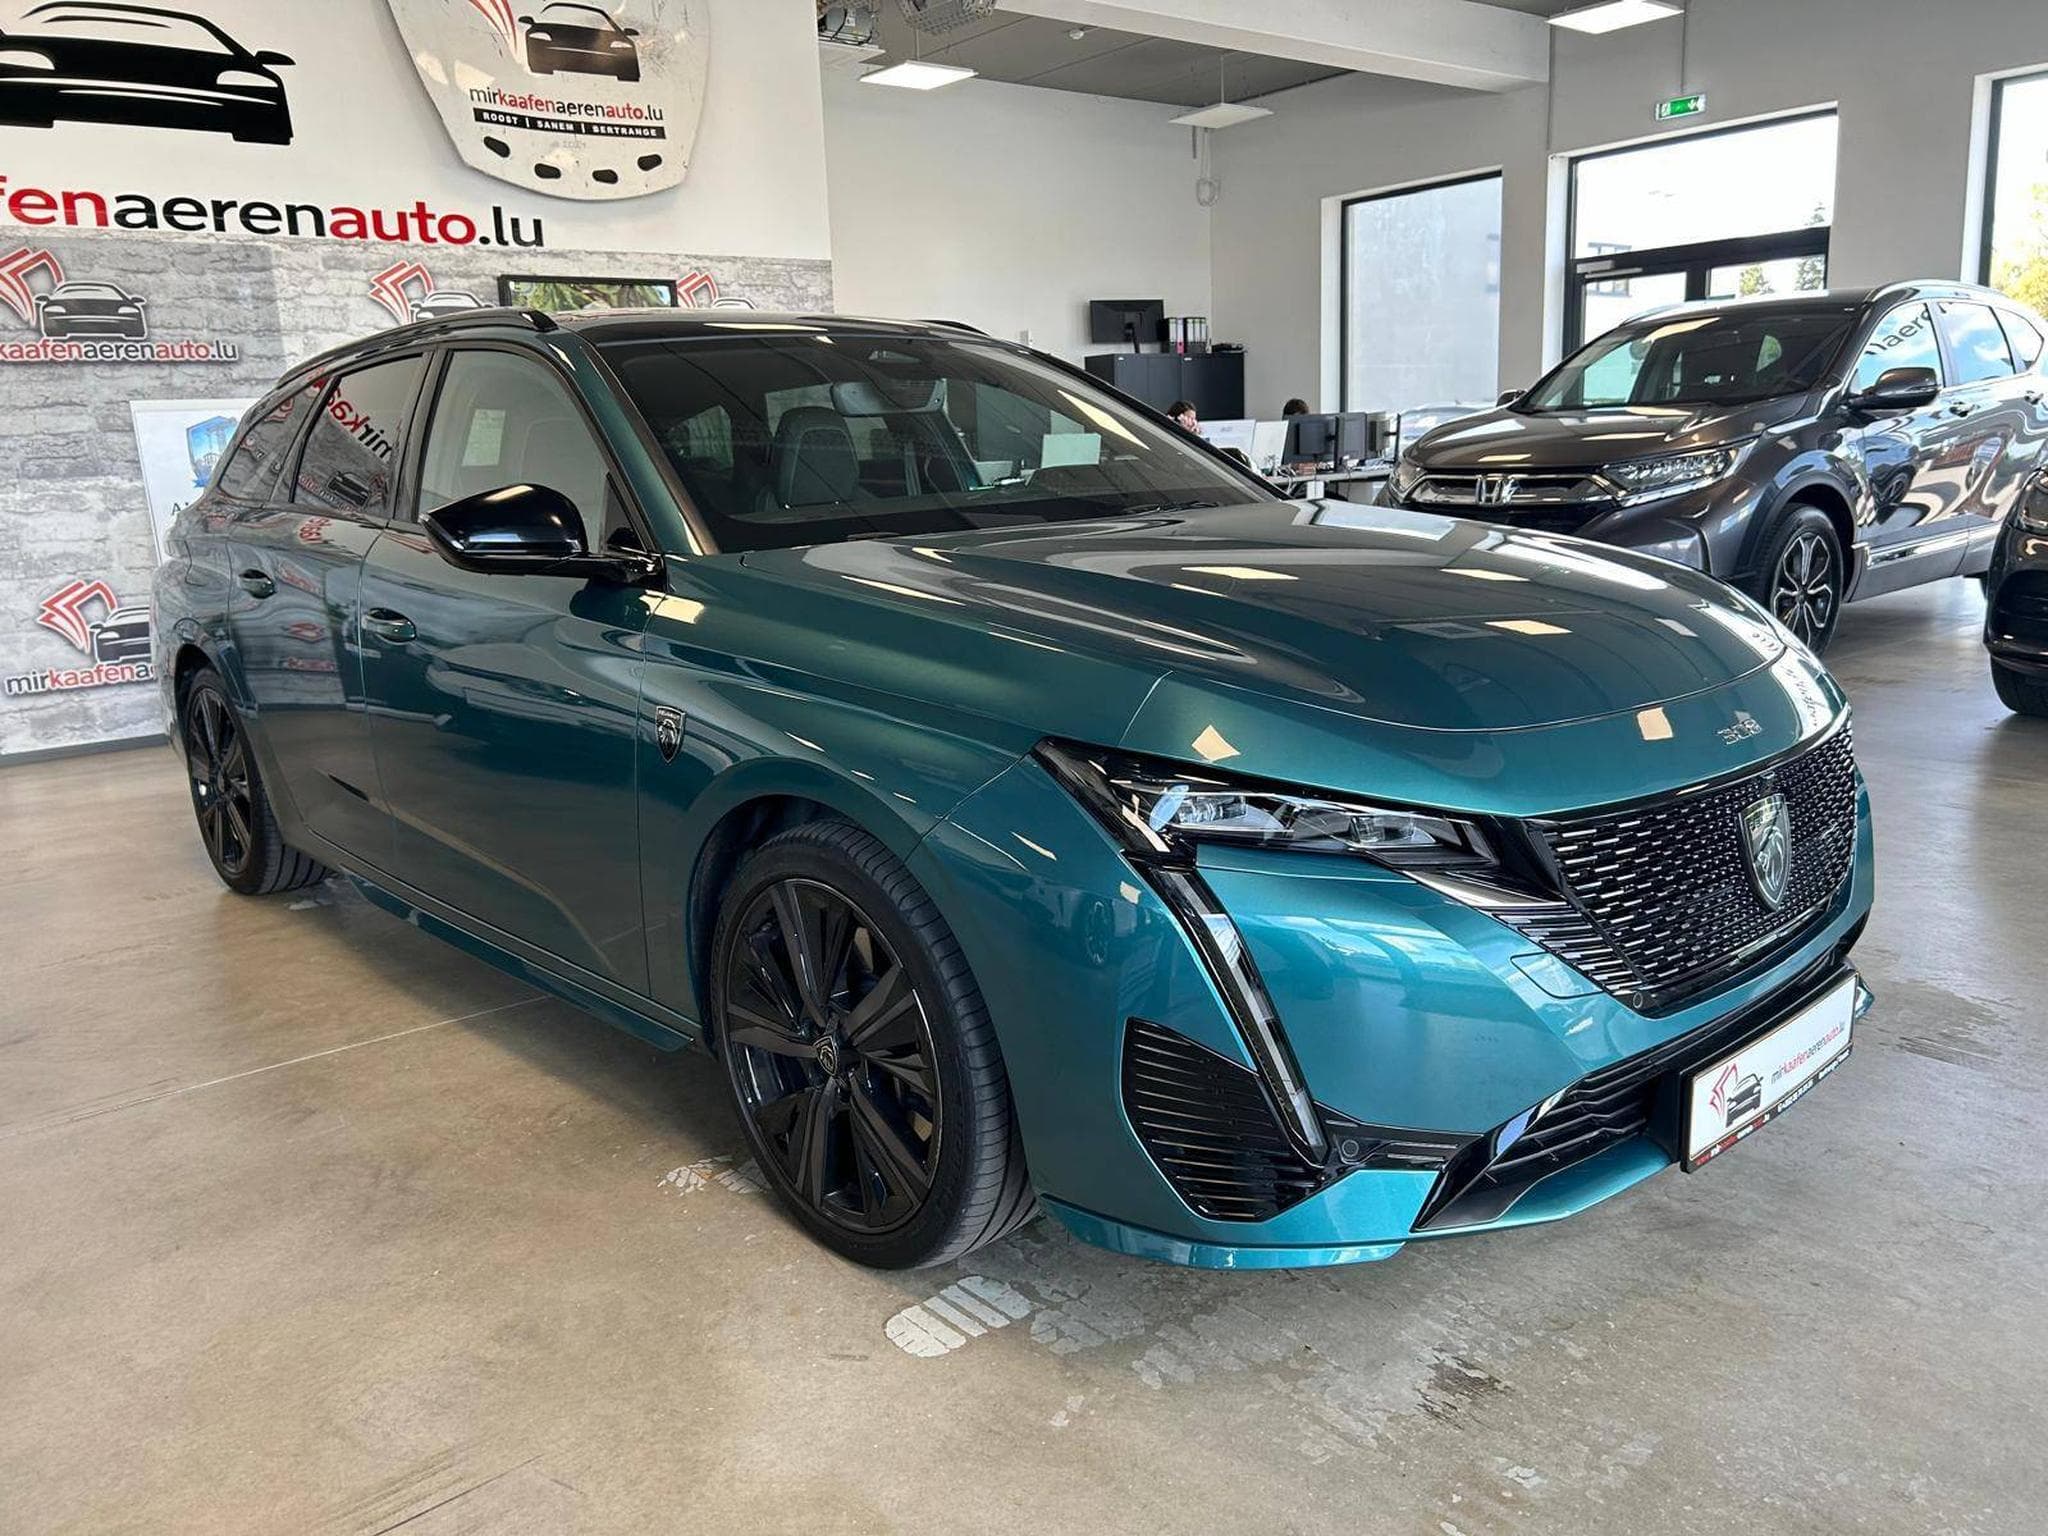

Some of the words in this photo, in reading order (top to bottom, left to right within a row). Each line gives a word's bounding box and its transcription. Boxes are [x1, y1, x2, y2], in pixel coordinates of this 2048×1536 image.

[470, 87, 663, 121] mirkaafenaerenauto.lu
[482, 112, 518, 125] ROOST
[537, 120, 574, 131] SANEM
[6, 663, 155, 693] mirkaafena
